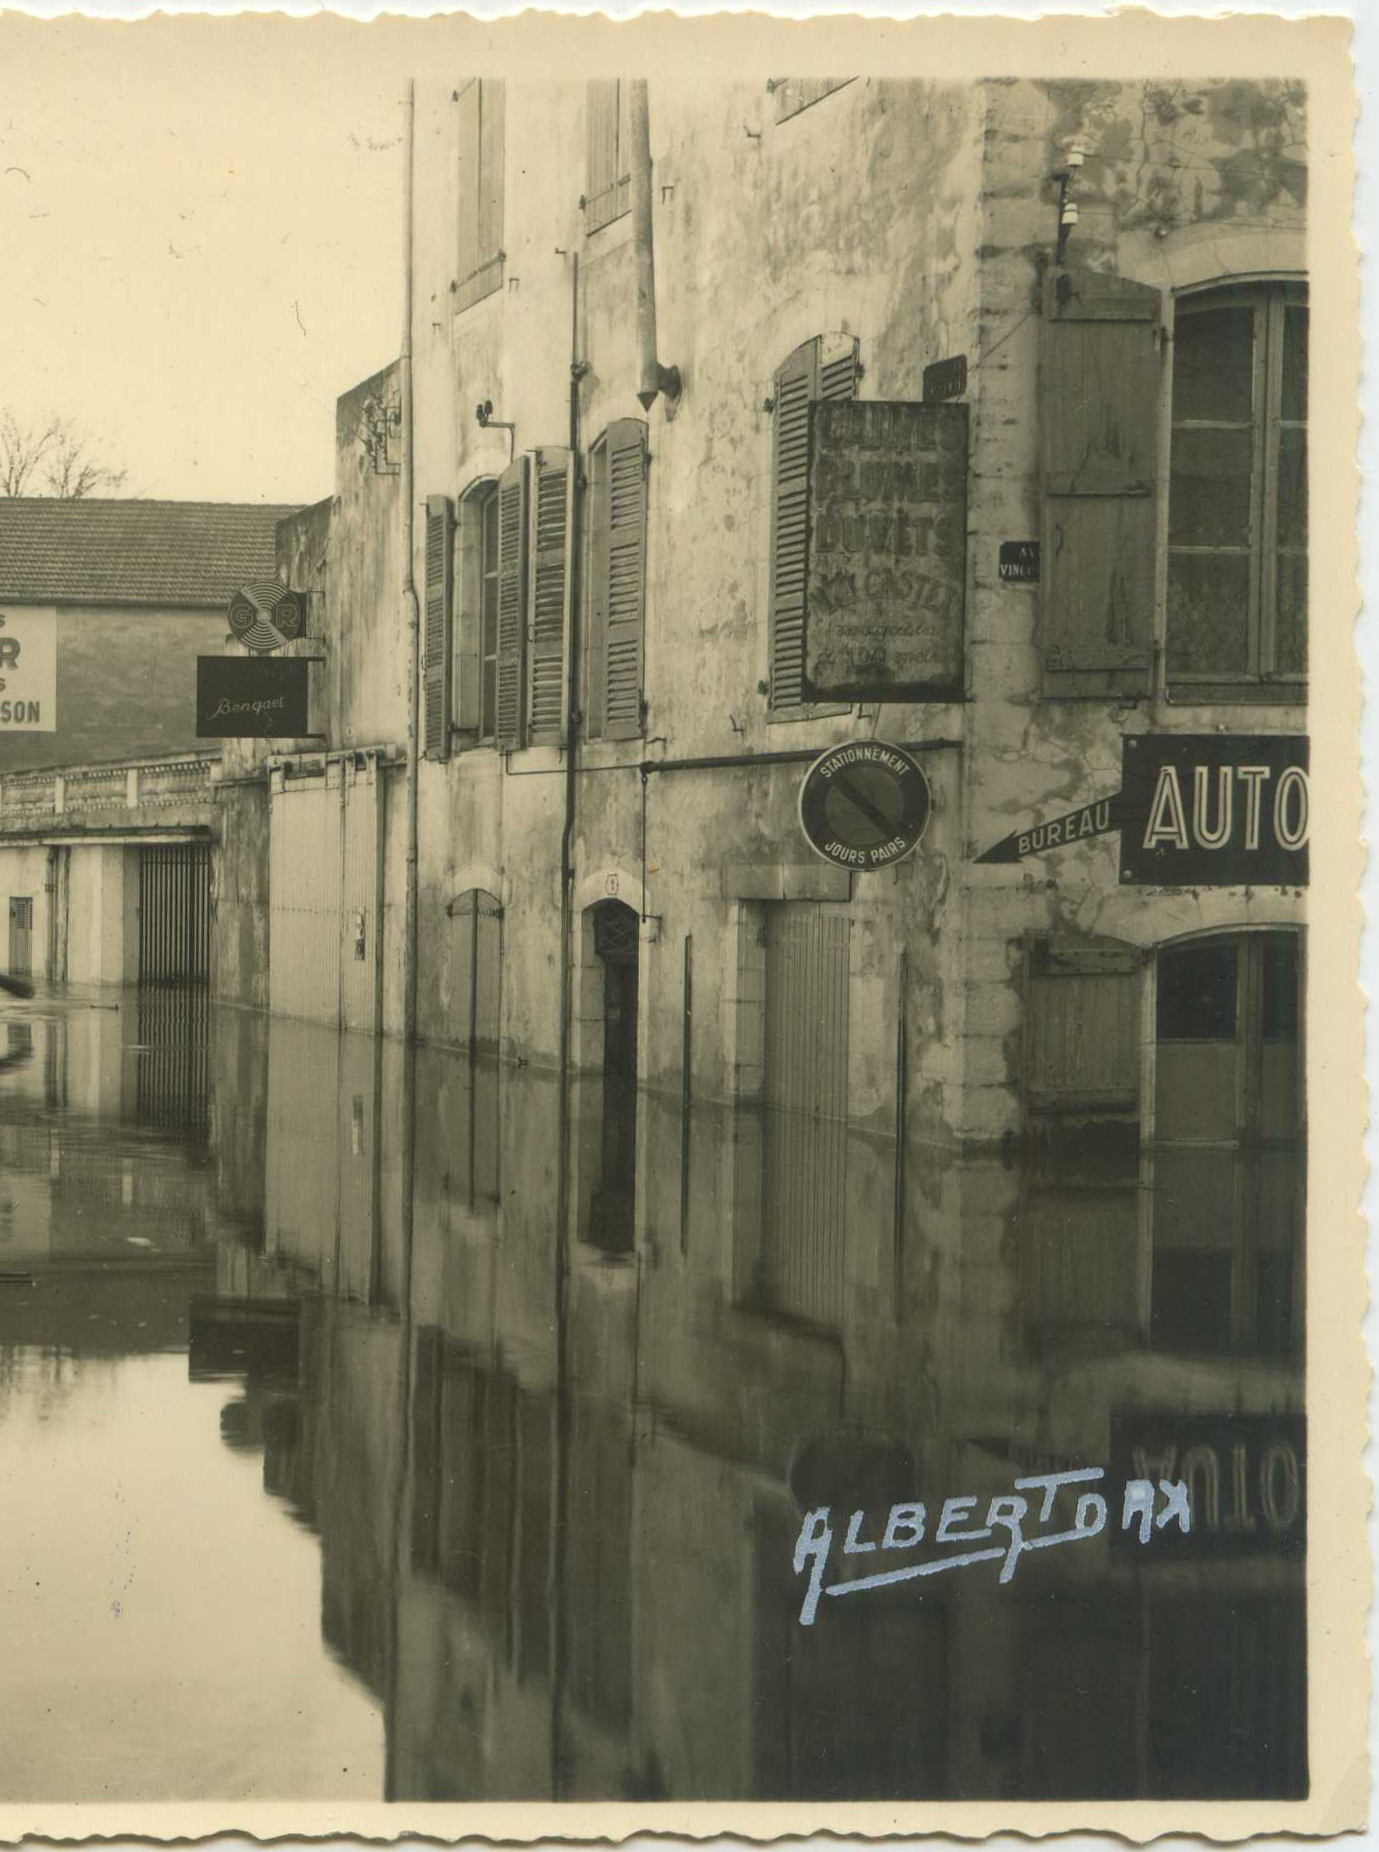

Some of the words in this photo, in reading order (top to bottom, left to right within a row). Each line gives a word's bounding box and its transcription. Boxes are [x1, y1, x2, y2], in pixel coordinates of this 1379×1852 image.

[819, 747, 911, 779] STATIONNEMENT
[1017, 800, 1111, 856] BUREAU
[1142, 764, 1309, 851] AUTO
[824, 841, 866, 864] JOURS
[870, 836, 907, 863] PAIRS
